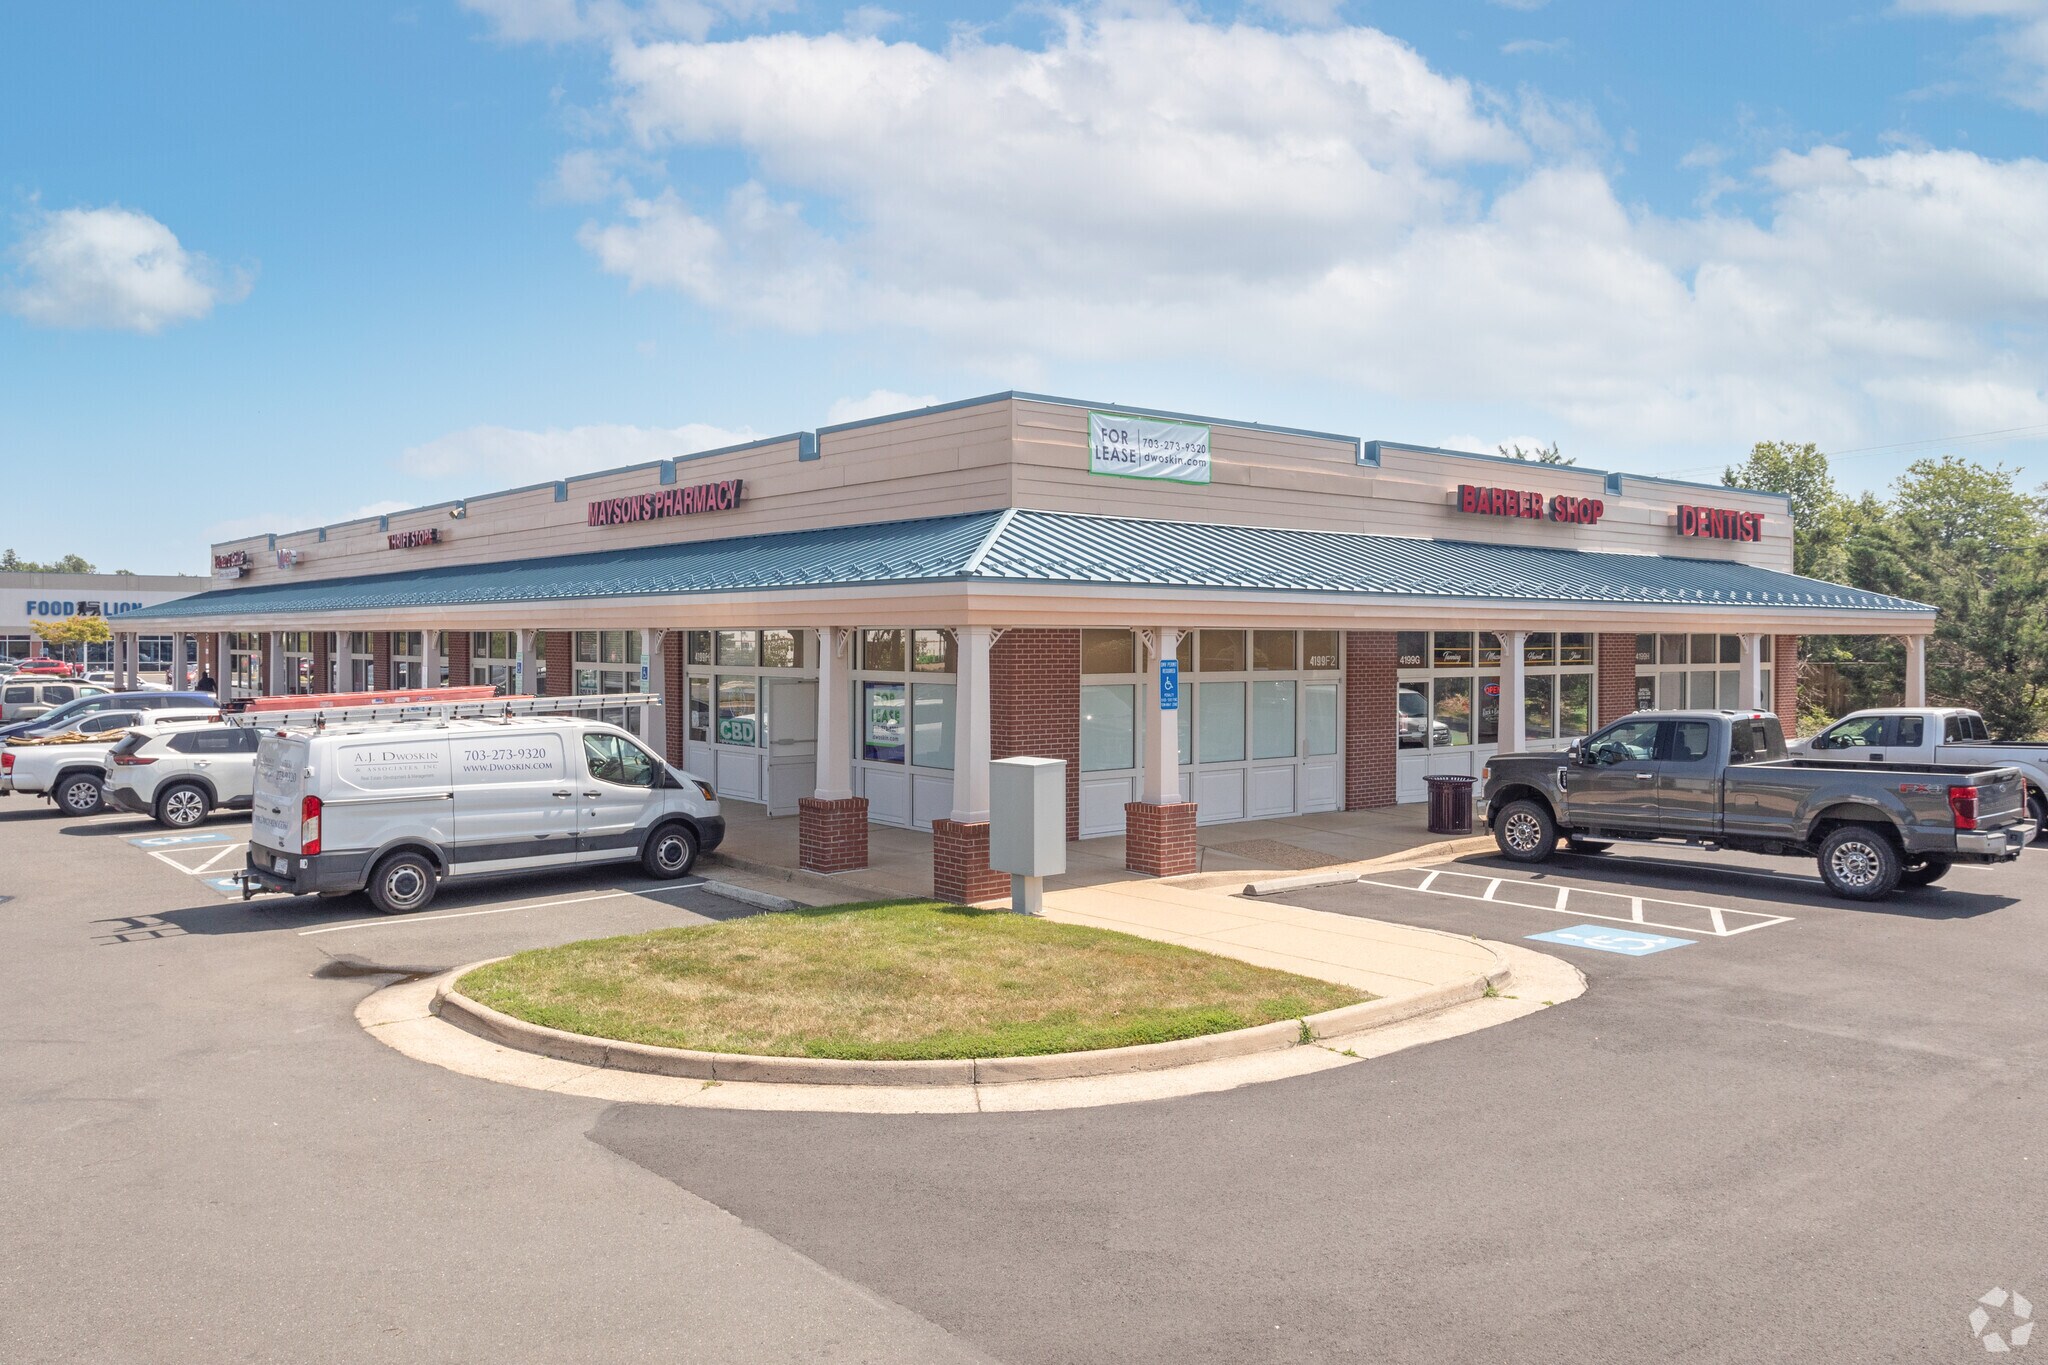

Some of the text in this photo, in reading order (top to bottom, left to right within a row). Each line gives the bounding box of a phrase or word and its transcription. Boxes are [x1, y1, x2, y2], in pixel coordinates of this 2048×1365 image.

[1101, 427, 1128, 445] FOR
[1095, 445, 1136, 463] LEASE
[1142, 438, 1206, 454] 703-273-9320
[1144, 452, 1207, 467] dwoskin.com
[588, 480, 740, 526] MAYSON'S PHARMACY
[1460, 485, 1604, 524] BARBER SHOP
[1680, 505, 1765, 542] DENTIST
[387, 528, 433, 550] THRIFT STORE
[26, 601, 75, 616] FOOD
[1309, 655, 1336, 667] 4199F2
[1399, 655, 1420, 665] 4199G
[720, 720, 754, 741] CBD
[354, 752, 376, 763] A.J.
[464, 747, 546, 761] 703-273-9320
[1899, 783, 1943, 793] FX4
